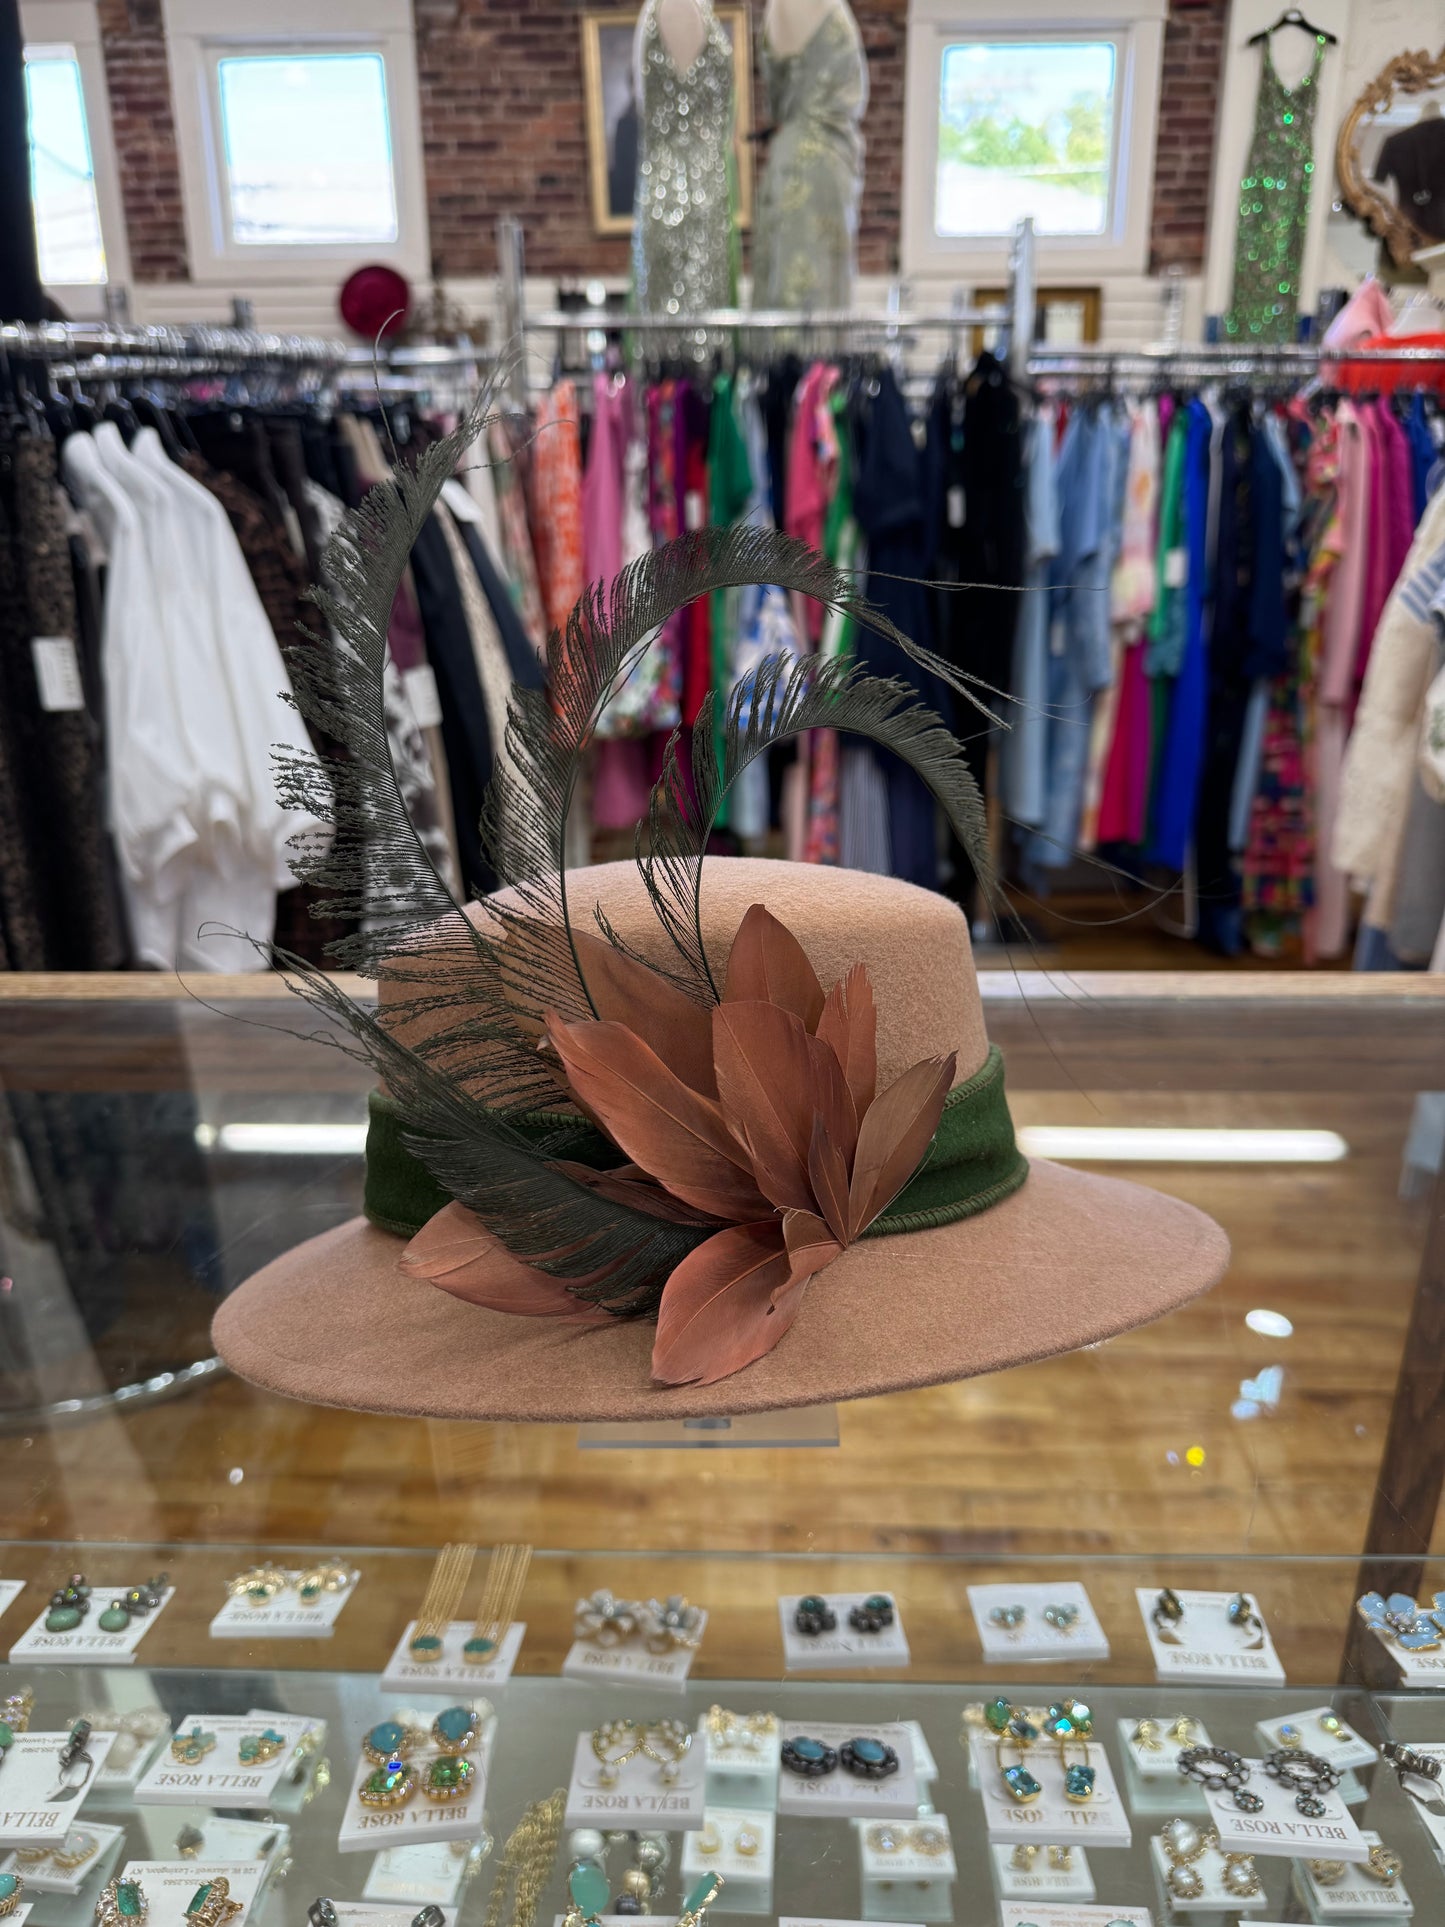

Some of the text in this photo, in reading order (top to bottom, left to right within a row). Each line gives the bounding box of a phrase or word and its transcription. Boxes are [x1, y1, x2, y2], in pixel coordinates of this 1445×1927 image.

[154, 1773, 263, 1788] BELLA ROSE
[582, 1795, 690, 1810] BELLA ROSE
[2, 1812, 60, 1828] BELLA
[357, 1806, 468, 1829] BELLA ROSE
[1229, 1819, 1348, 1841] BELLA ROSE
